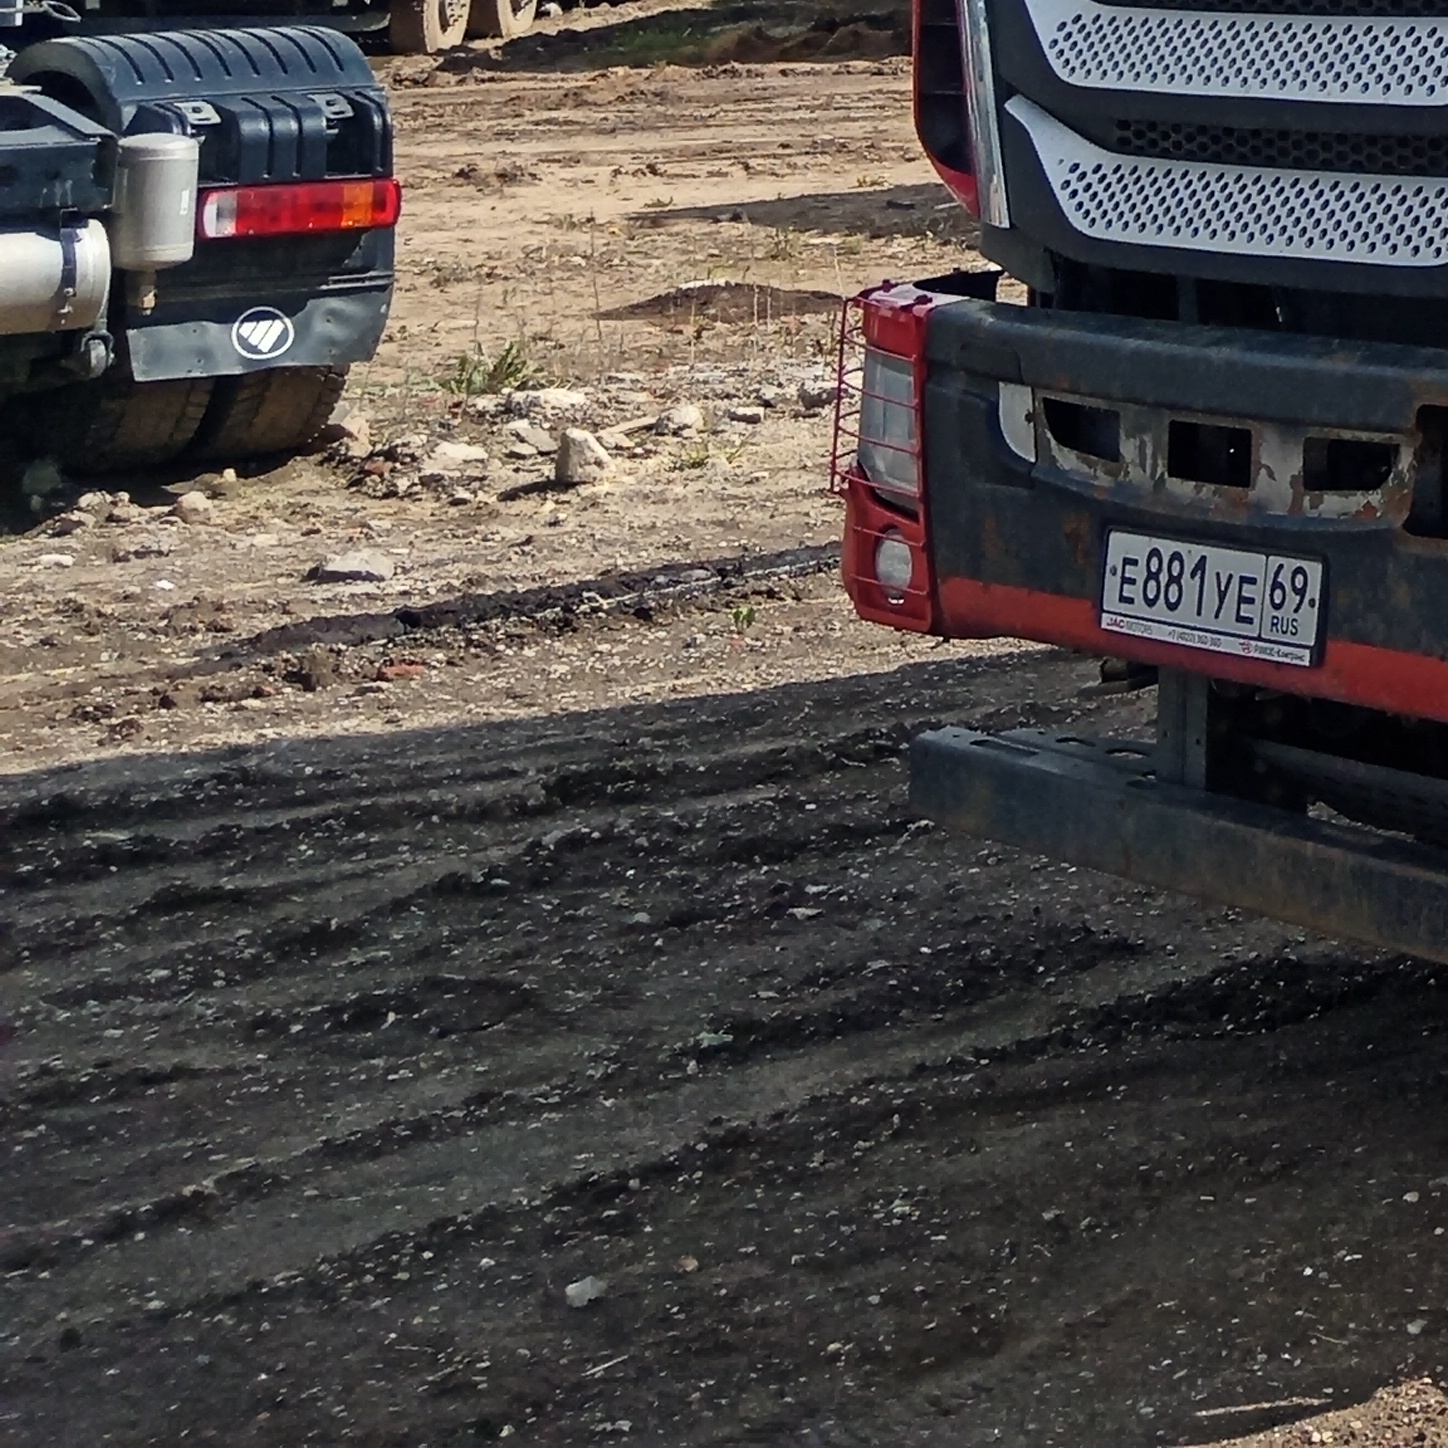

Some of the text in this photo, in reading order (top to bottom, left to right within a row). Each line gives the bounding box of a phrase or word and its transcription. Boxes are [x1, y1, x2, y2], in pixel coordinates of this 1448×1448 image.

[1118, 547, 1308, 625] Е881УЕ 69
[1269, 615, 1299, 636] RUS
